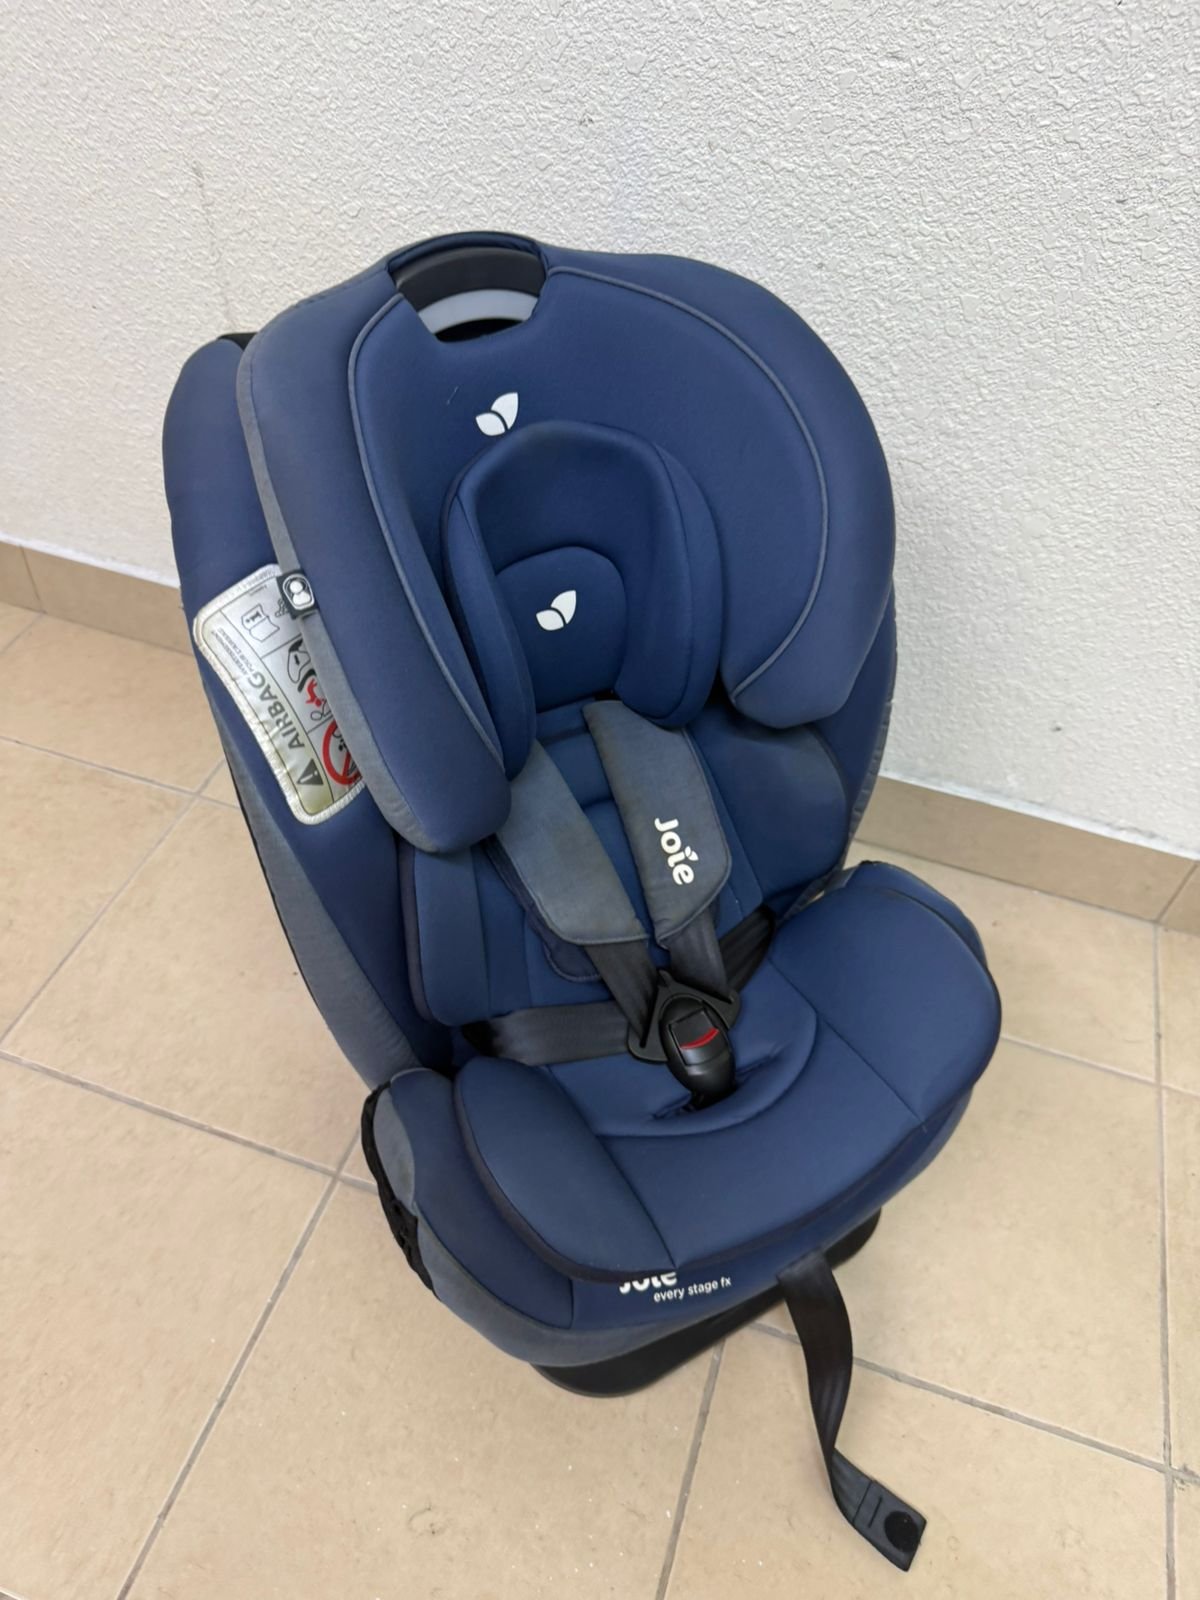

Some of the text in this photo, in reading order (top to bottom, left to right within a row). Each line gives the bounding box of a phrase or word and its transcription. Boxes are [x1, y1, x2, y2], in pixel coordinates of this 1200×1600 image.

[248, 670, 304, 748] AIRBAG
[654, 817, 699, 885] Joie
[653, 1275, 732, 1302] every stage fx
